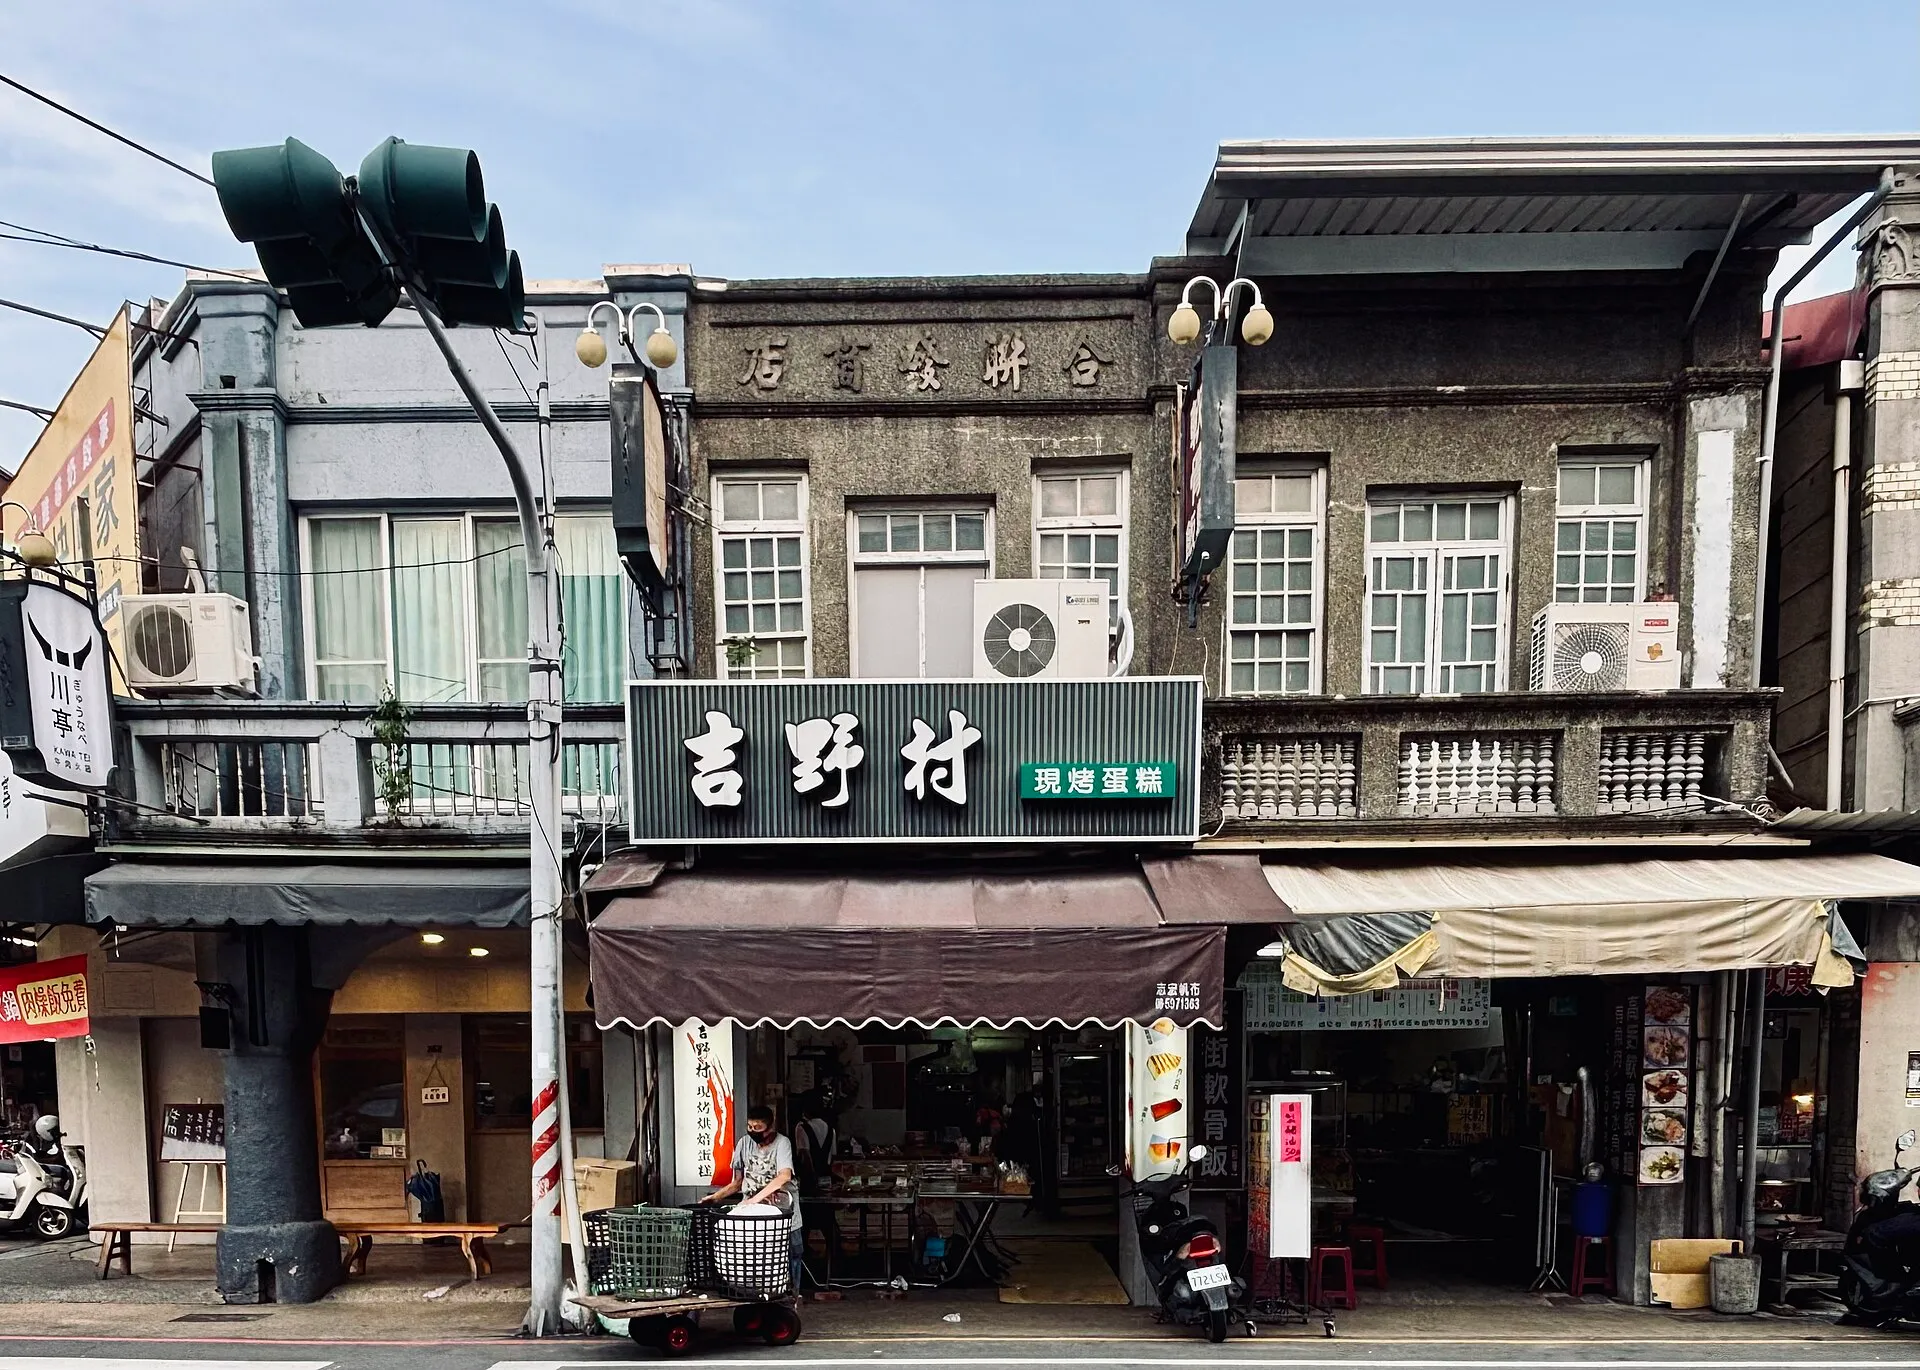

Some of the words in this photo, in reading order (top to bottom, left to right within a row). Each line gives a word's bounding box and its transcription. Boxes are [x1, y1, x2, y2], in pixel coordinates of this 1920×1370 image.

[51, 671, 73, 738] 川亭
[73, 679, 88, 745] ぎゅうなべ
[53, 746, 77, 759] KAWA
[683, 708, 982, 808] 吉野村
[1034, 767, 1163, 796] 現烤蛋糕
[1156, 982, 1201, 997] 志宏帆布
